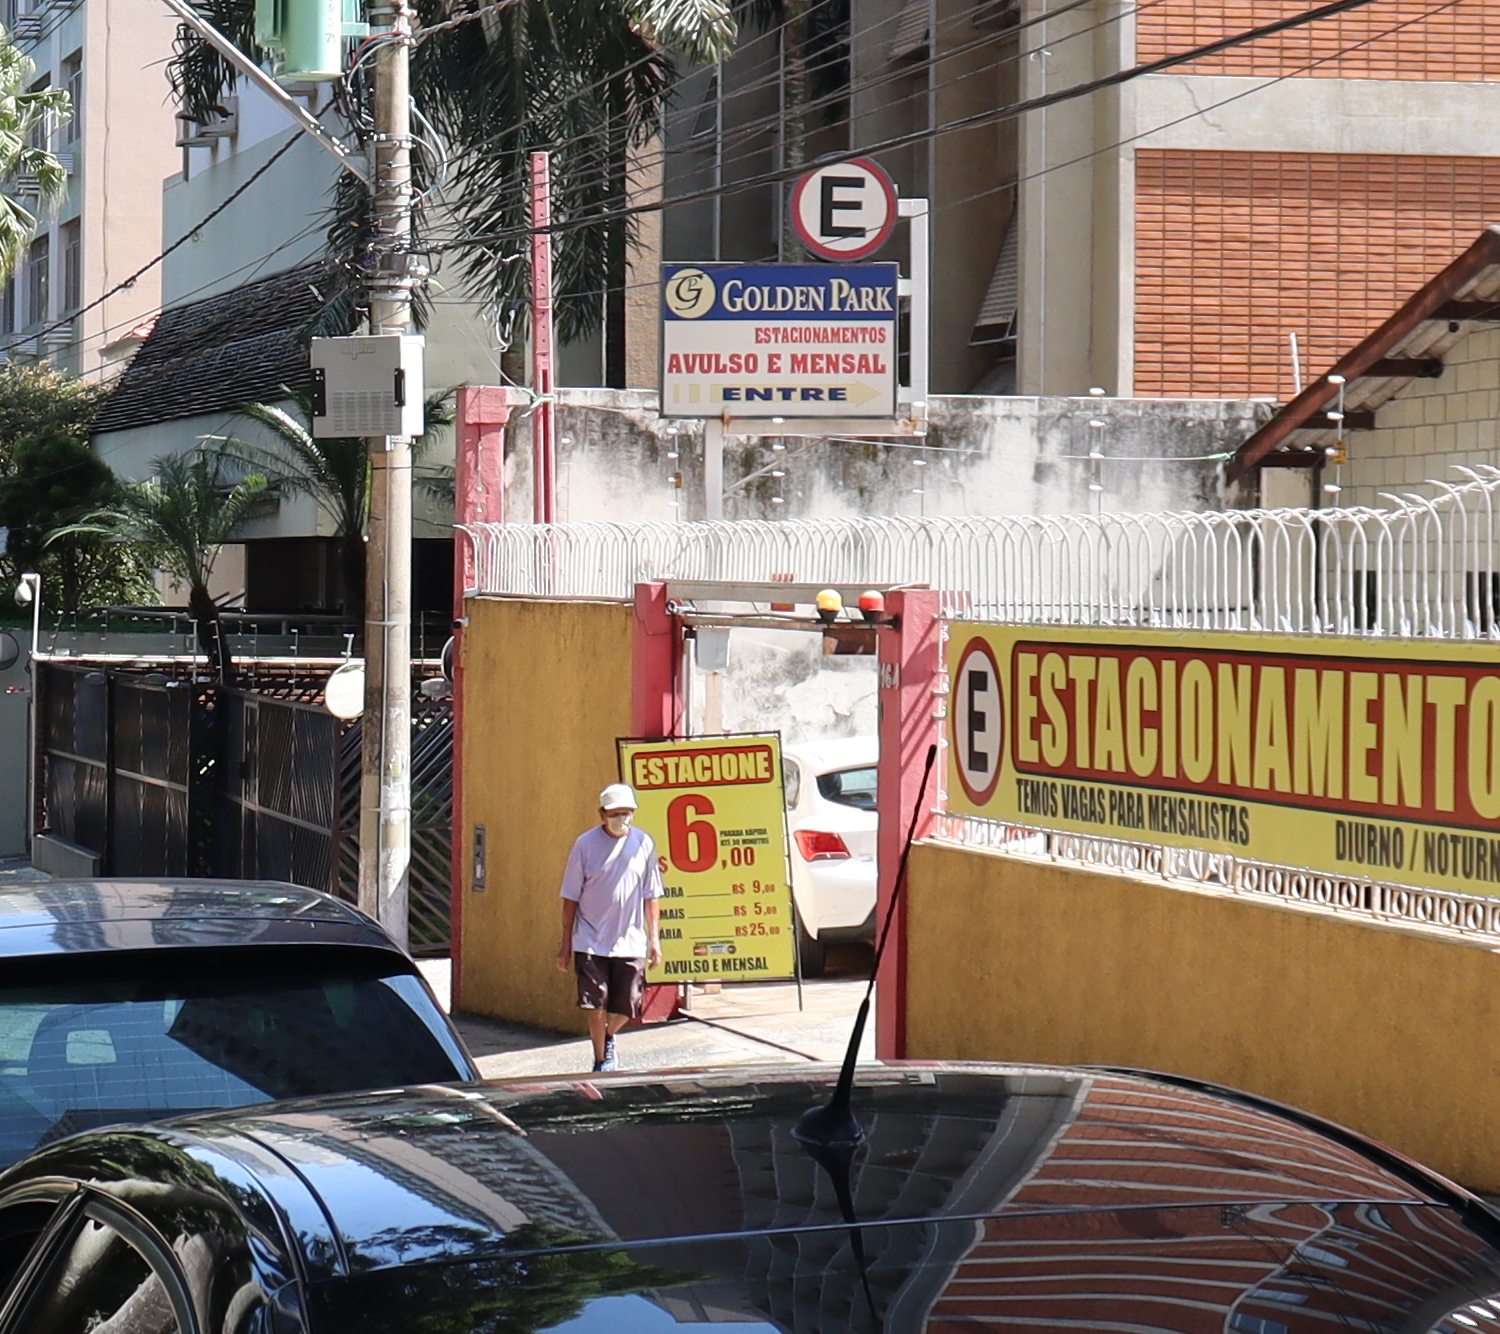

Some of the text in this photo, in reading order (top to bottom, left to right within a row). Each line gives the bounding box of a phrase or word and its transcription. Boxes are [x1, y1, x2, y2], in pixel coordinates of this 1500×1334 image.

[820, 176, 866, 238] E
[721, 278, 894, 312] GOLDEN PARK
[755, 327, 887, 344] ESTACIONAMENTOS
[667, 353, 886, 374] AVULSO E MENSAL
[722, 387, 848, 401] ENTRE
[881, 662, 900, 690] 164
[968, 670, 989, 773] E
[634, 752, 771, 786] ESTACIONE
[1016, 778, 1250, 847] TEMOS VAGAS PARA MENSALISTAS
[1335, 820, 1404, 870] DIURNO
[664, 887, 684, 898] ORA
[664, 956, 769, 974] AVULSO E MENSAL
